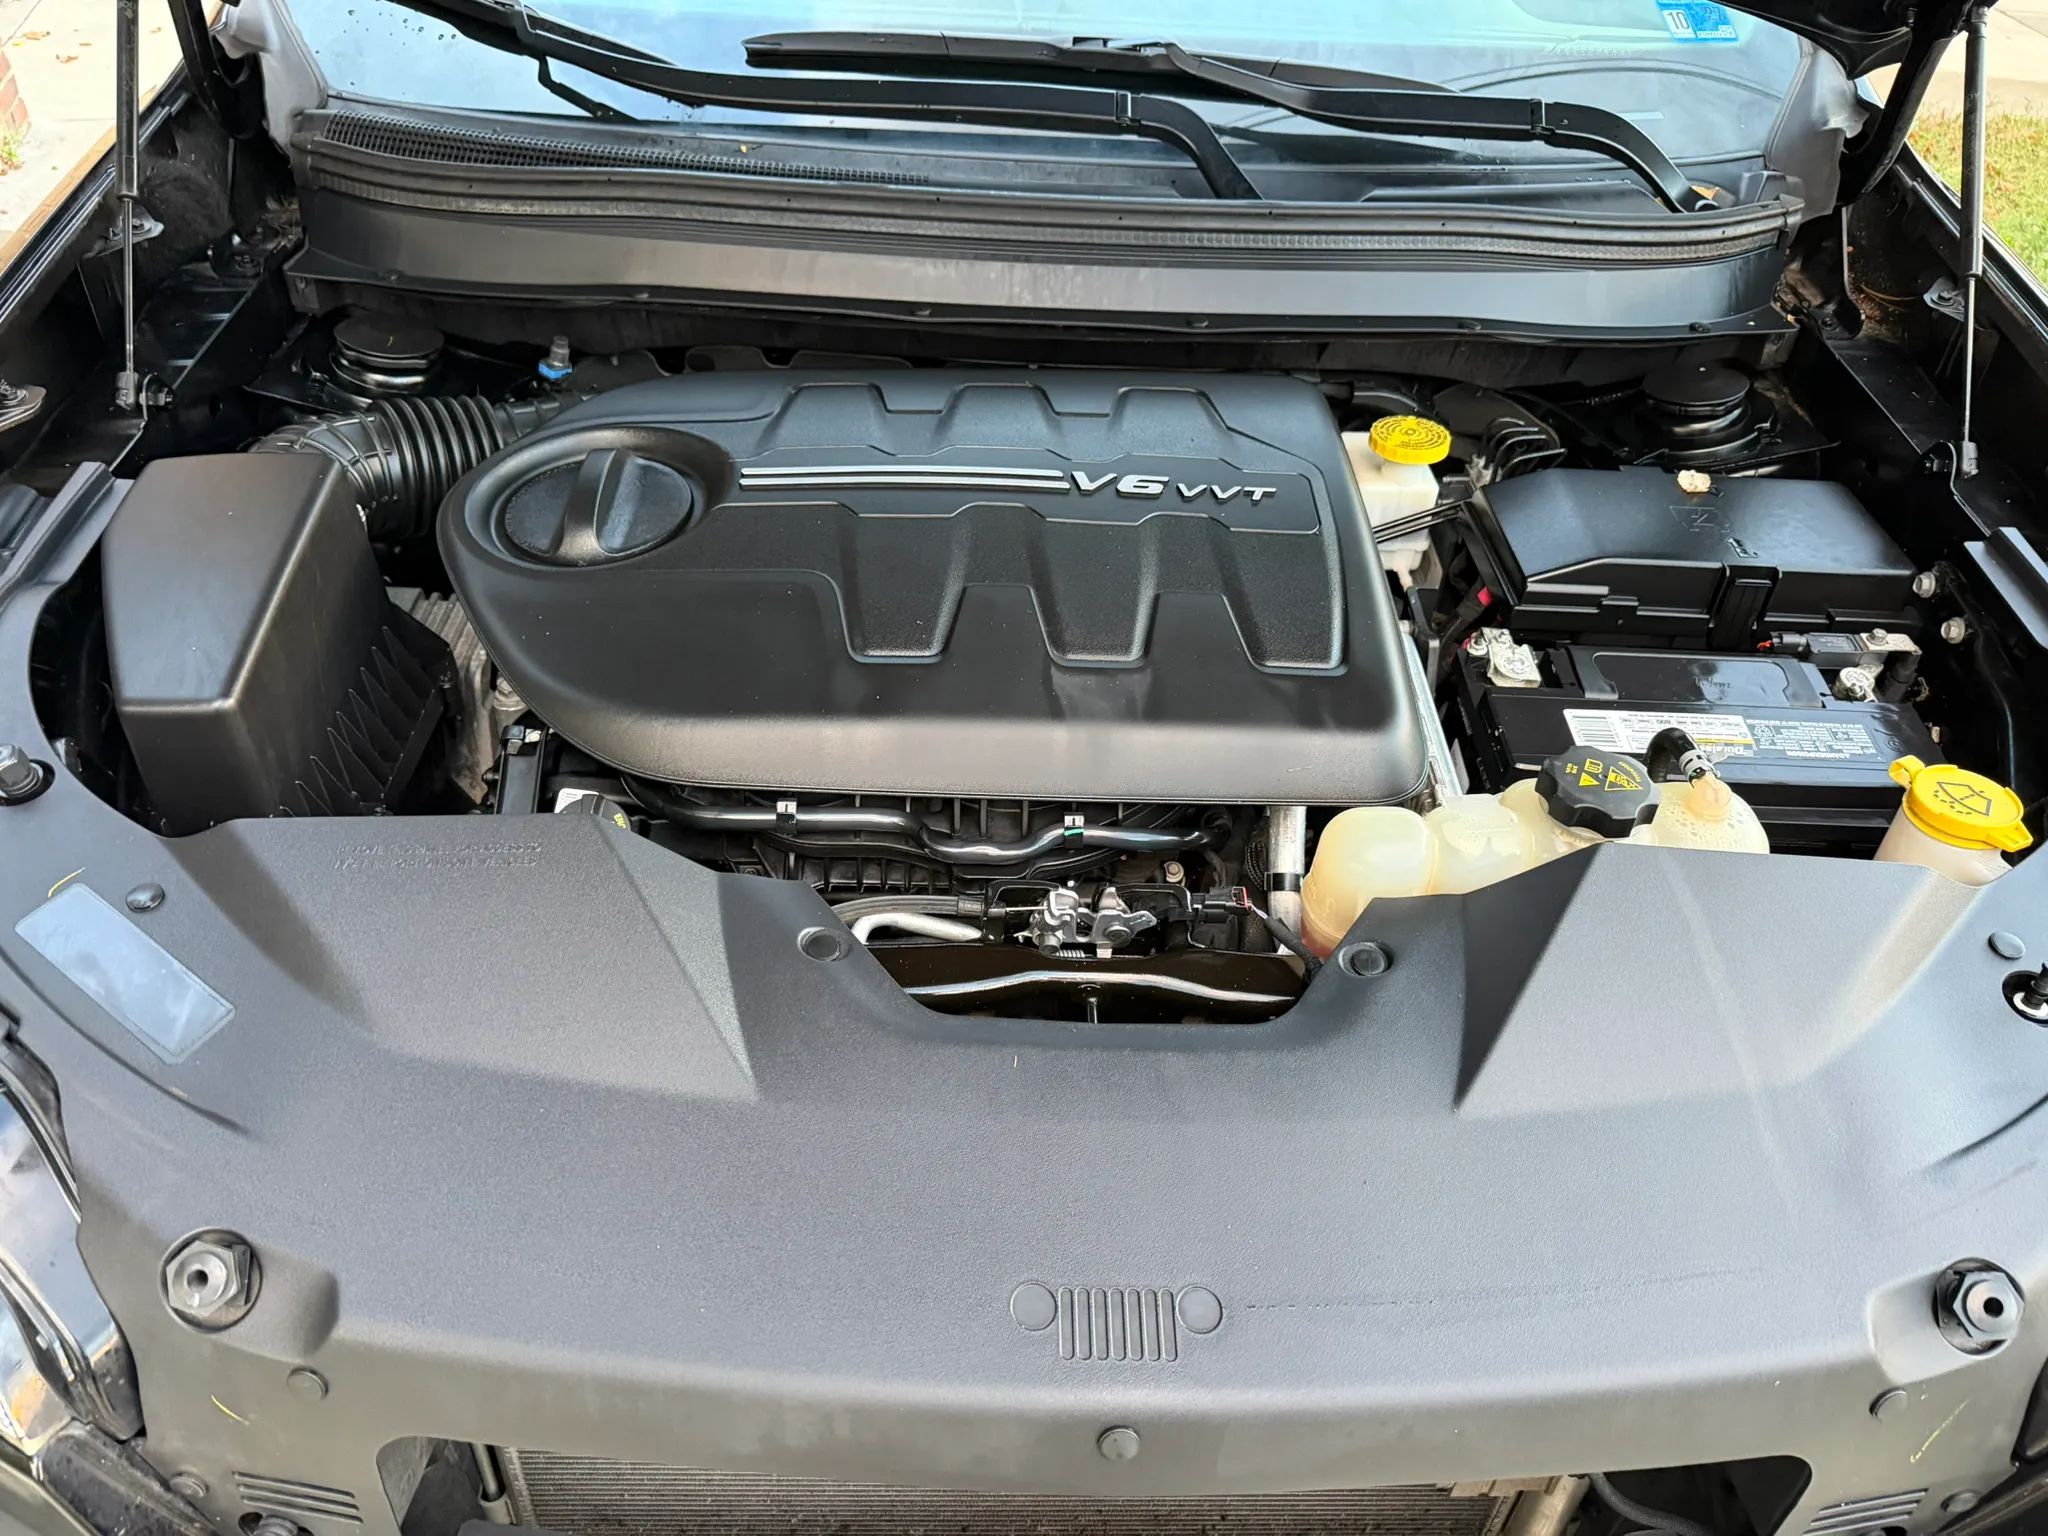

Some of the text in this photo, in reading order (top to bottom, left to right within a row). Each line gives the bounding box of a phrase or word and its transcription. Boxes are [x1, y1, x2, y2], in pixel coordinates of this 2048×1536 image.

[1666, 11, 1690, 30] 10
[1071, 471, 1277, 501] V6 VVT
